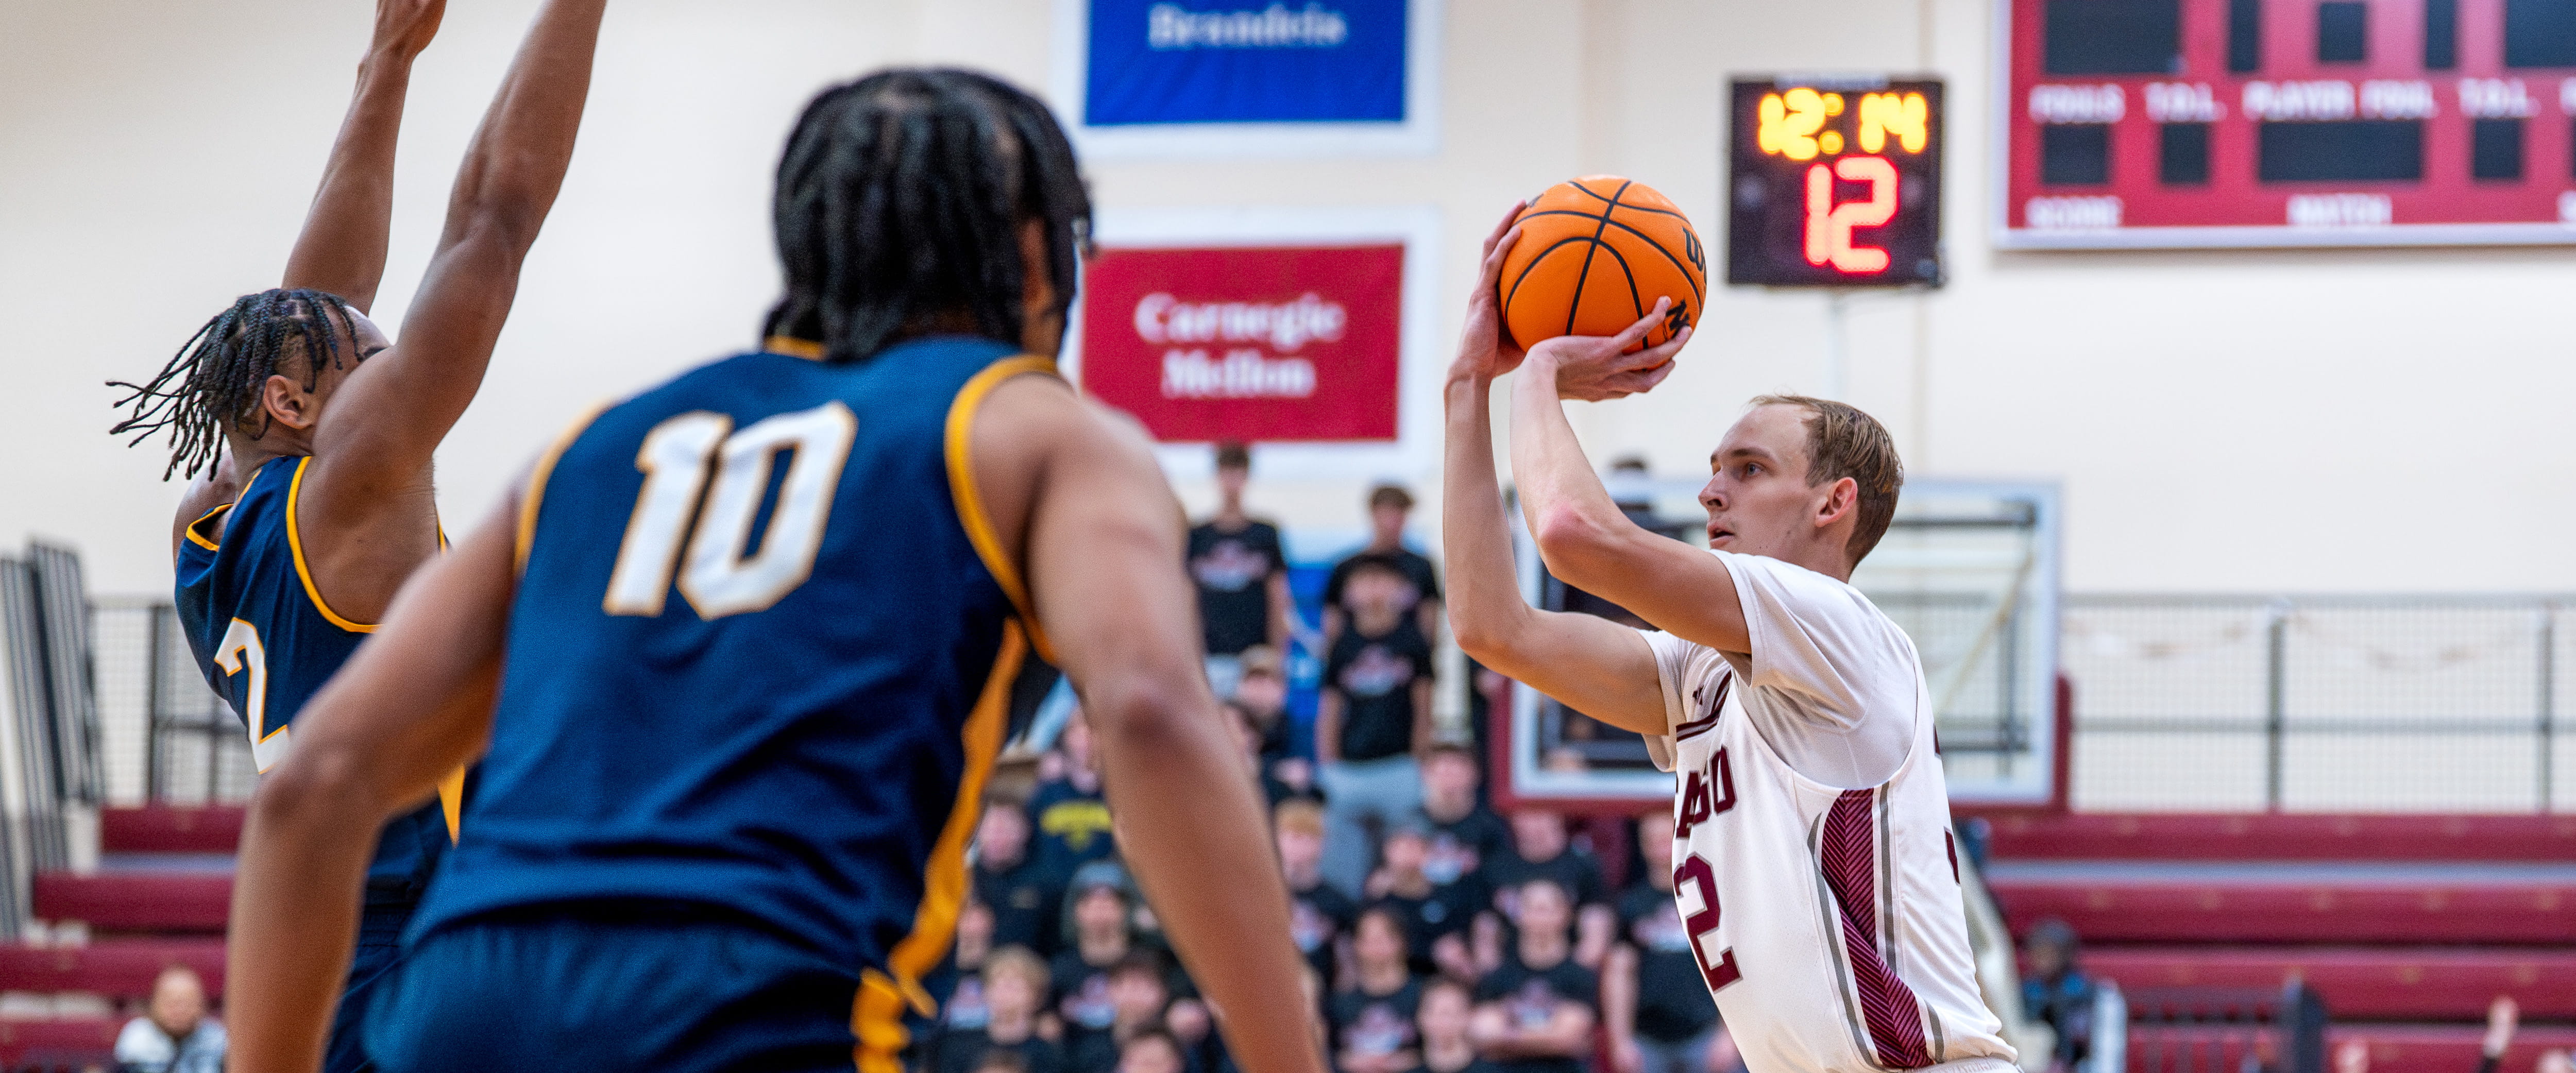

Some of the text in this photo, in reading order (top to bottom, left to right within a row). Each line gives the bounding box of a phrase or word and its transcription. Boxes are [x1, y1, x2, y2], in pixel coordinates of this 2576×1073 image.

[1147, 3, 1347, 49] Brandeis
[1758, 88, 1928, 160] 12:14
[2030, 84, 2124, 123] FOULS
[2243, 81, 2355, 120] PLAYER
[1804, 155, 1900, 275] 12
[1135, 293, 1345, 351] Carnegie
[1160, 349, 1316, 398] Mellon
[602, 400, 858, 622] 10
[214, 617, 290, 774] 2
